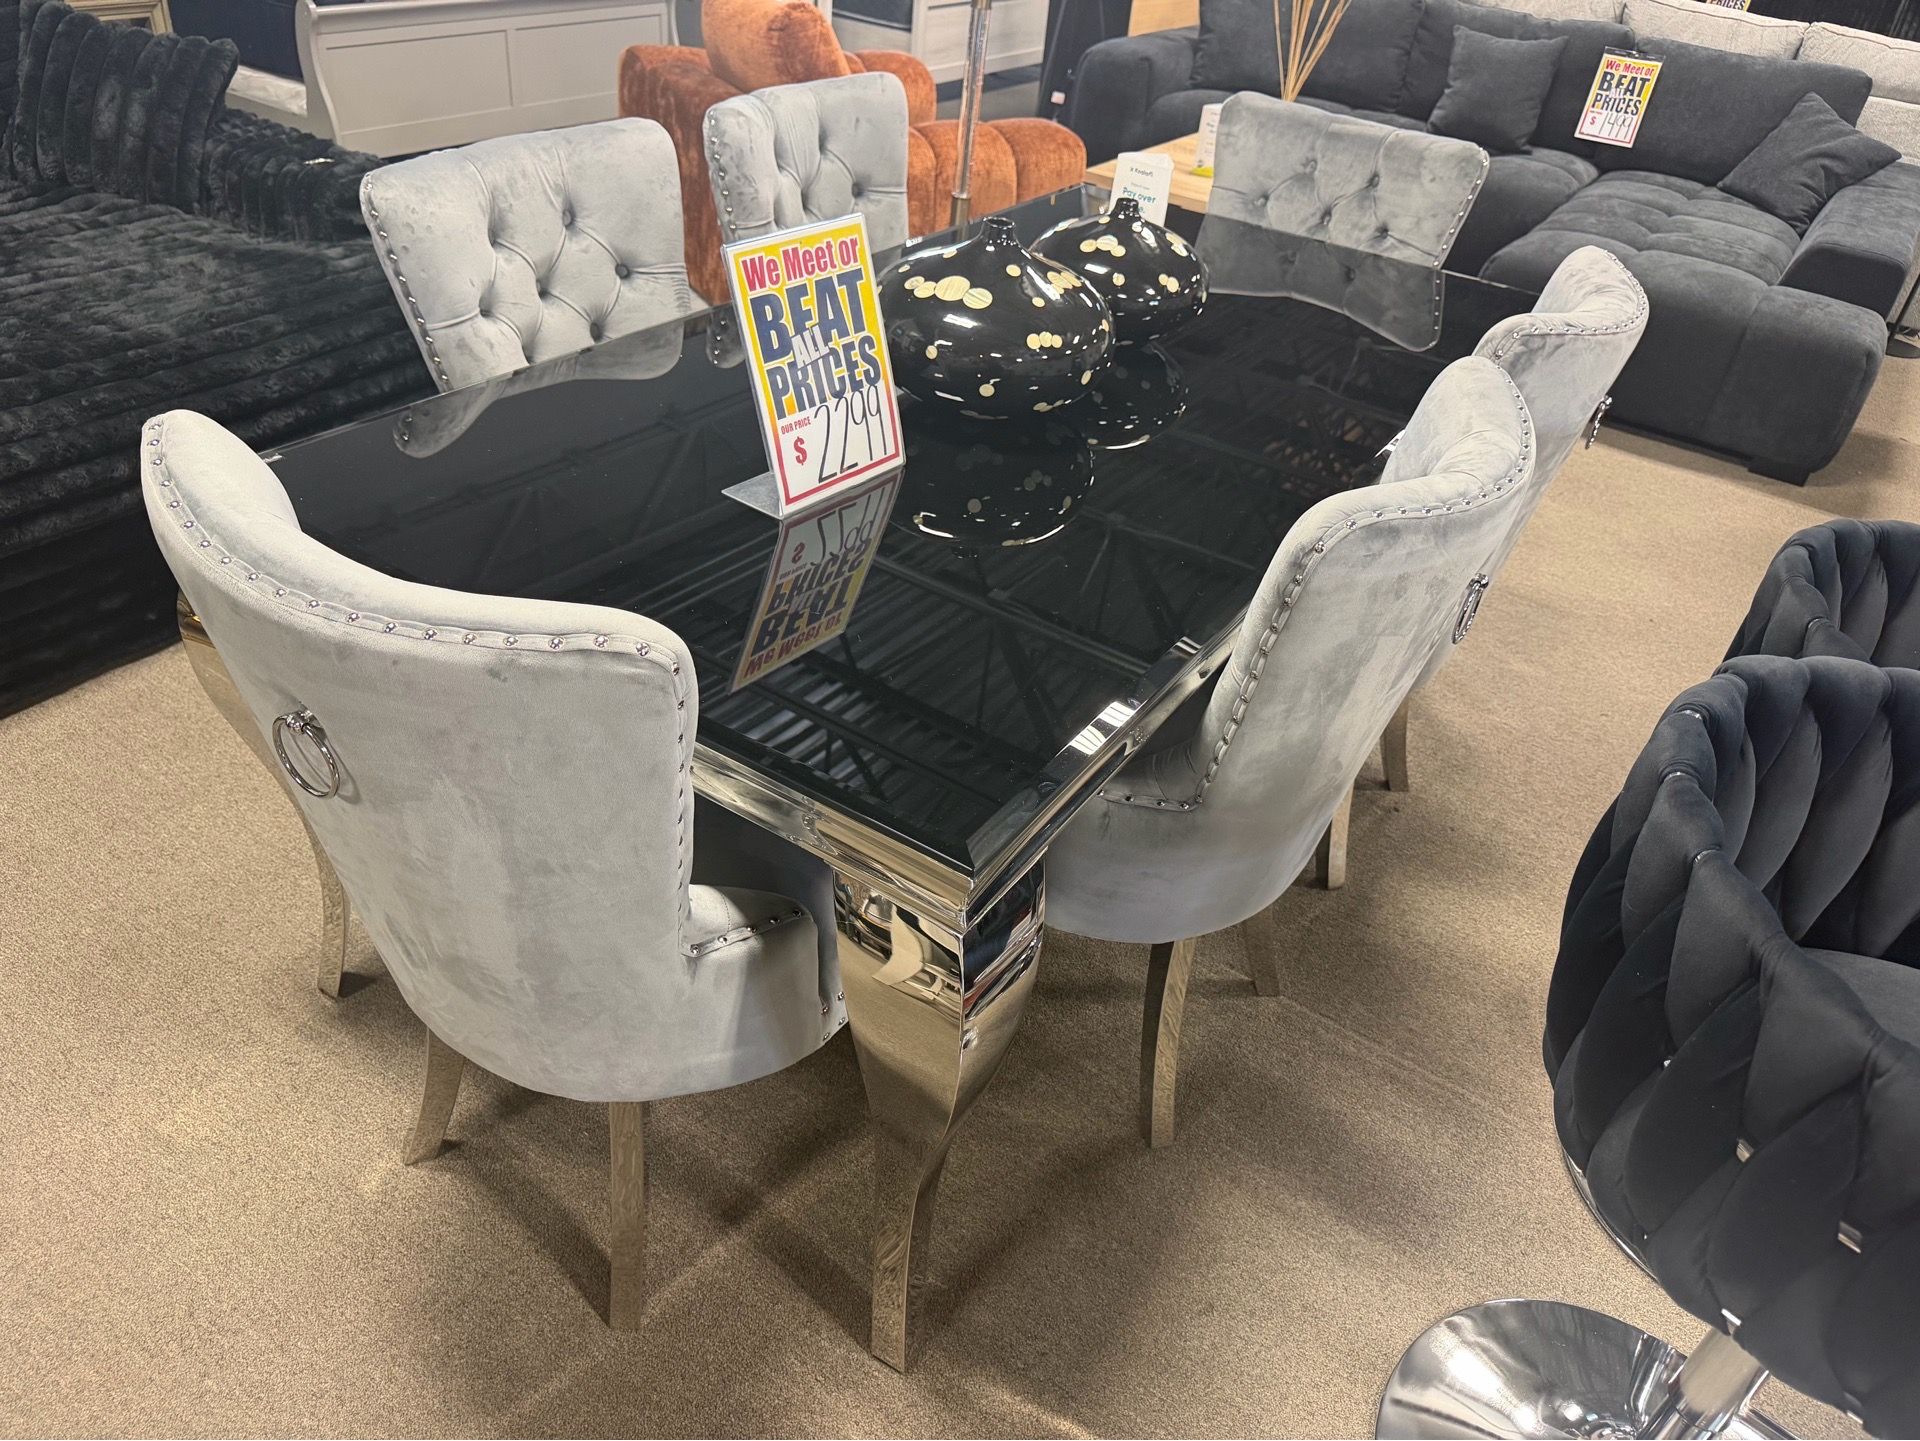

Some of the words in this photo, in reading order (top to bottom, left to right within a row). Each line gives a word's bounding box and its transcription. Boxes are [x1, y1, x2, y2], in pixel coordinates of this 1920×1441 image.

[1606, 59, 1621, 71] We
[1622, 63, 1644, 76] Meet
[1645, 68, 1655, 77] or
[1597, 71, 1651, 97] BEAT
[1591, 92, 1642, 117] PRICES
[1589, 116, 1597, 126] $
[1122, 186, 1137, 200] Pay
[1137, 193, 1157, 204] over
[741, 255, 780, 293] We
[782, 240, 838, 281] Meet
[838, 237, 859, 267] or
[749, 267, 866, 365] BEAT
[791, 324, 830, 370] ALL
[766, 334, 882, 421] PRICES
[780, 420, 794, 435] OUR
[794, 416, 812, 431] PRICE
[793, 436, 808, 466] $
[814, 385, 887, 484] 2299
